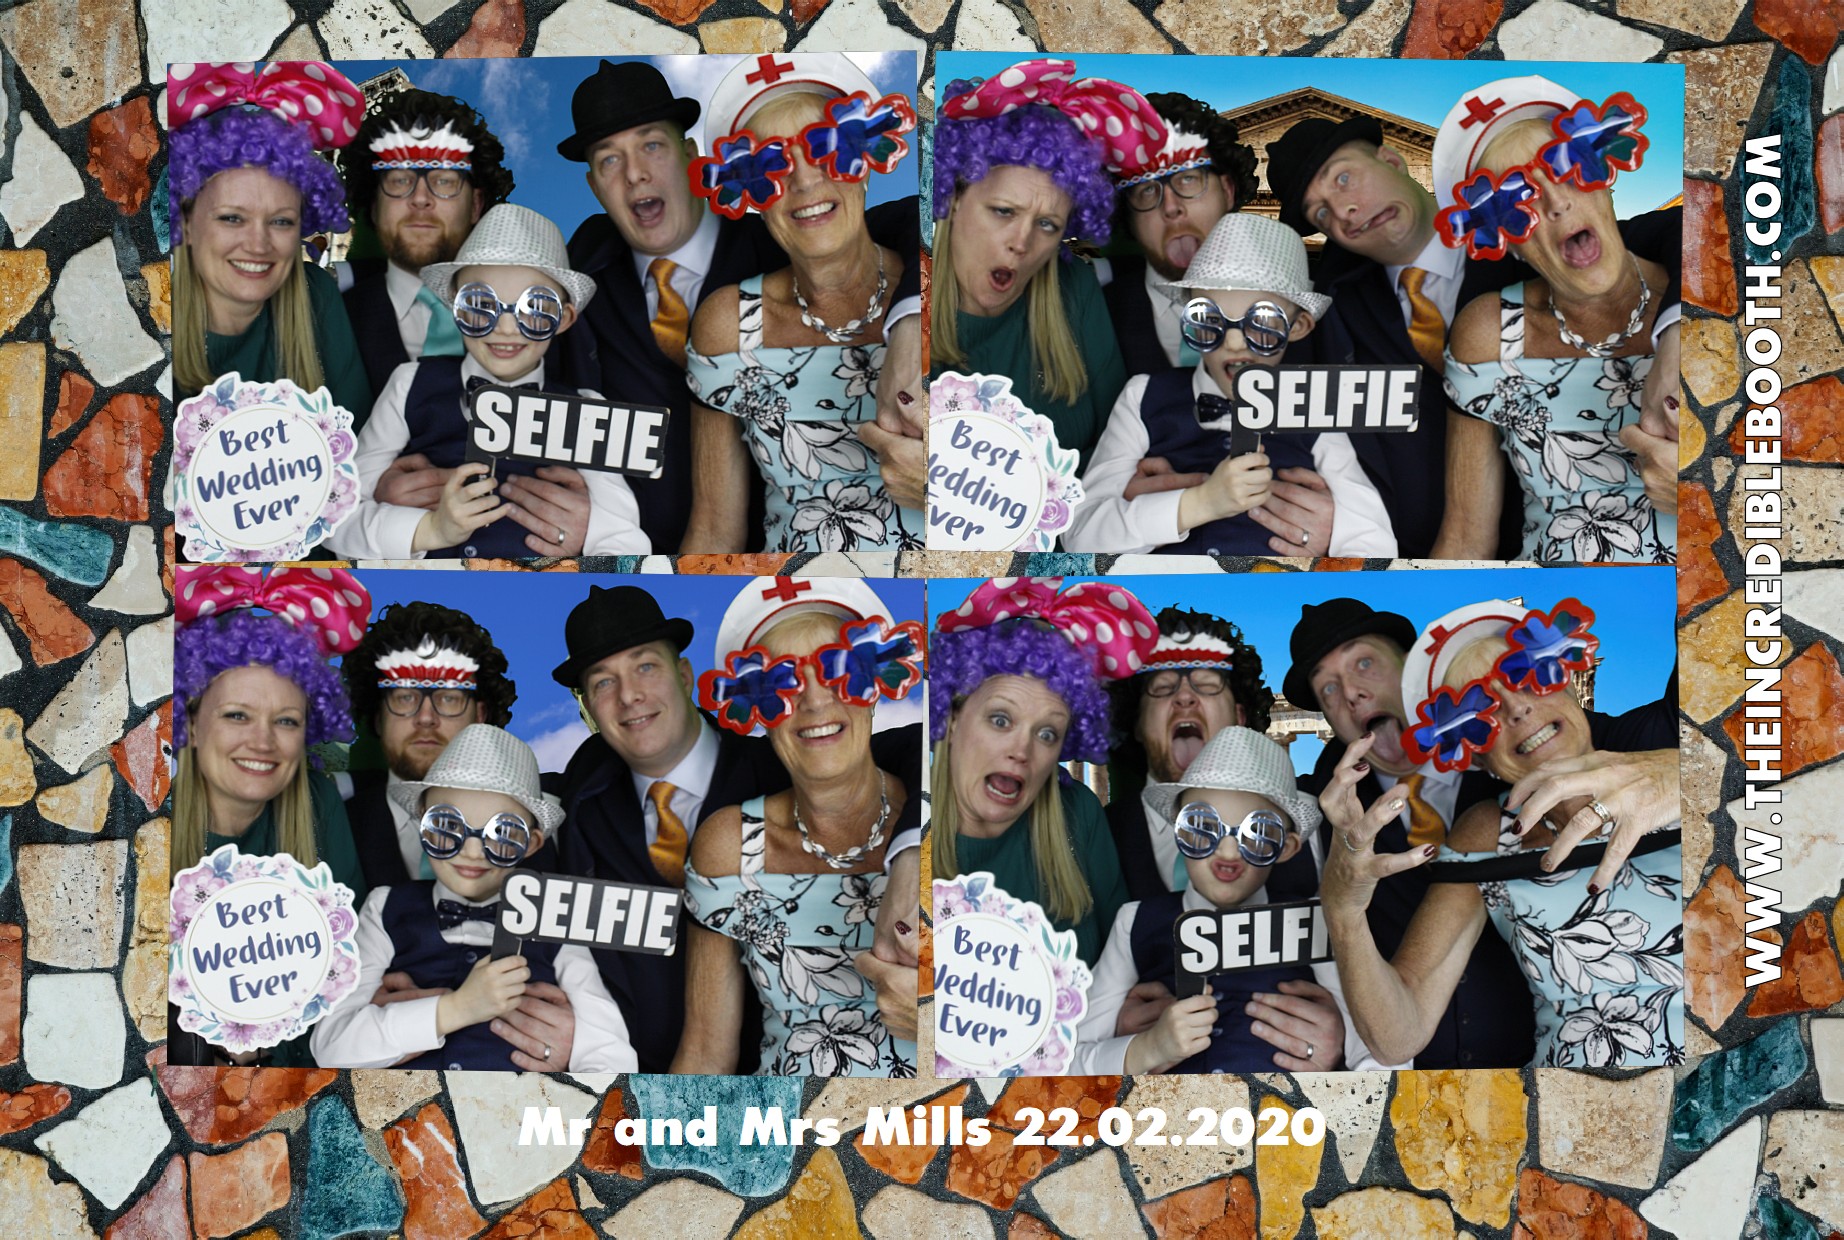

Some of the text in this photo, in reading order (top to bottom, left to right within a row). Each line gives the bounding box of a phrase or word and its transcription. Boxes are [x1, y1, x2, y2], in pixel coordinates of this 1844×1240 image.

[1237, 369, 1417, 430] SELFIE
[219, 419, 290, 456] Best
[473, 390, 664, 472] SELFIE
[950, 419, 1023, 475] Best
[197, 454, 323, 503] Wedding
[928, 453, 1028, 529] edding
[233, 494, 300, 530] Ever
[215, 894, 289, 929] Best
[502, 874, 679, 949] SELFIE
[192, 931, 322, 974] Wedding
[953, 925, 1023, 971] Best
[1179, 905, 1335, 973] SELFI
[229, 970, 298, 1004] Ever
[939, 1003, 1008, 1047] Ever
